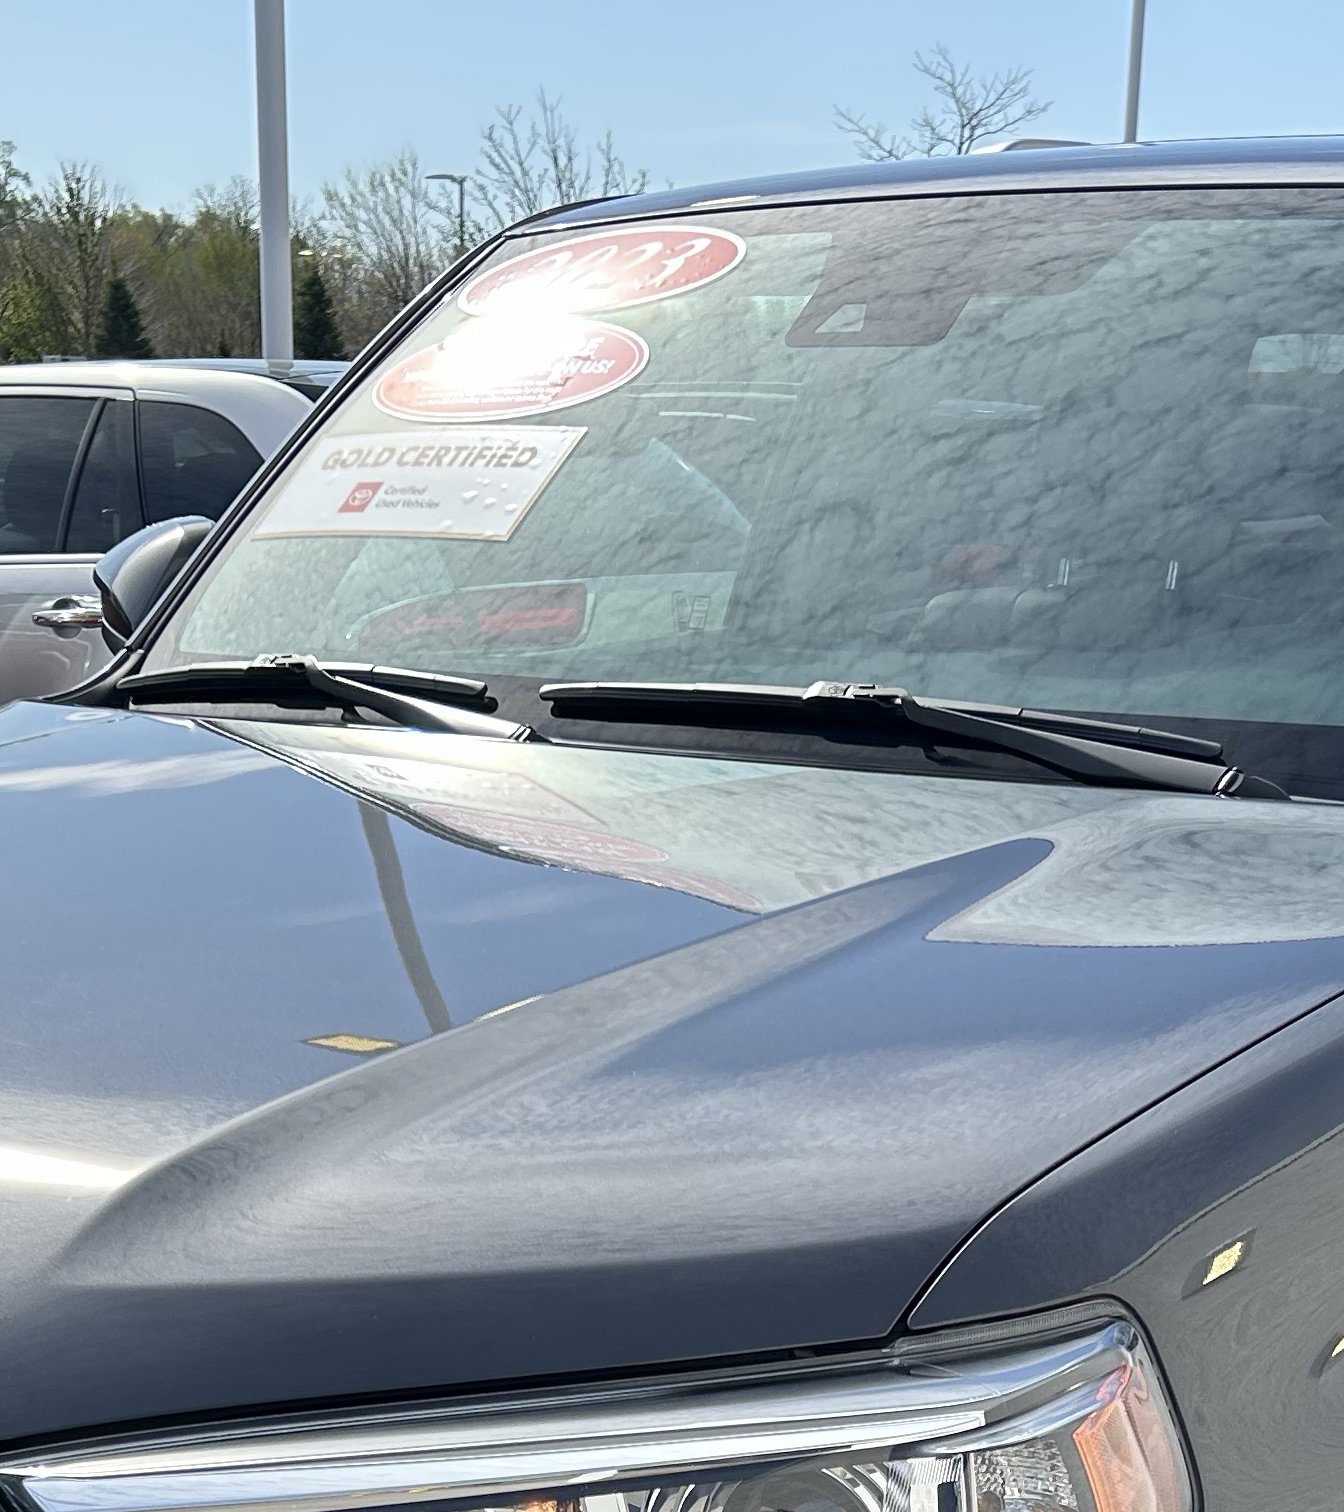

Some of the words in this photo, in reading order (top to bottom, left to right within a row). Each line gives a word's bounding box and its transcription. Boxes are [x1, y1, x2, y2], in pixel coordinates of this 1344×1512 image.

[322, 447, 396, 471] GOLD
[397, 445, 538, 468] CERTIFIED
[384, 485, 428, 497] Certified
[375, 498, 400, 510] Used
[401, 498, 440, 510] Vehicles
